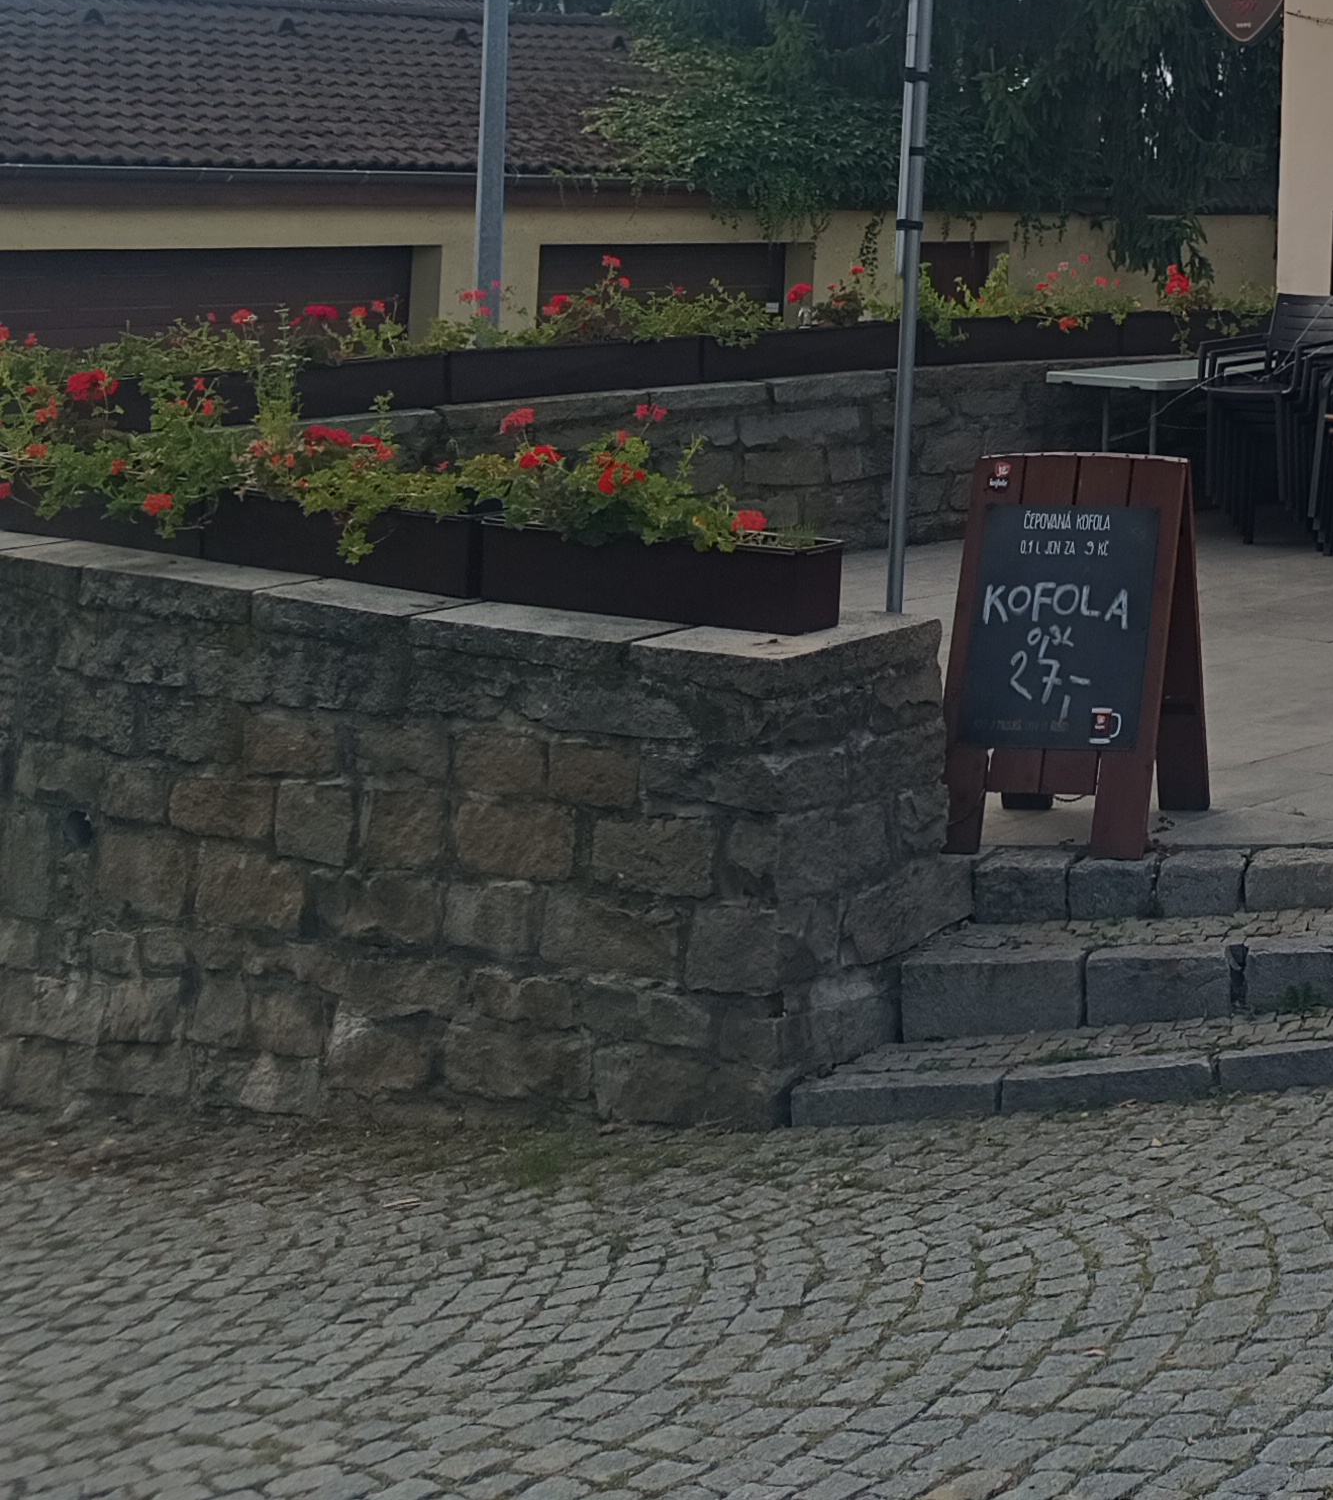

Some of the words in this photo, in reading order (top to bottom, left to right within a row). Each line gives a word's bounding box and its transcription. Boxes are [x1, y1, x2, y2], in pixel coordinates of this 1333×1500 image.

[1023, 511, 1072, 530] ČEPOVANÁ
[1076, 513, 1111, 531] KOFOLA
[1063, 541, 1076, 555] ZA
[1084, 541, 1095, 555] 9
[983, 581, 1129, 631] KOFOLA
